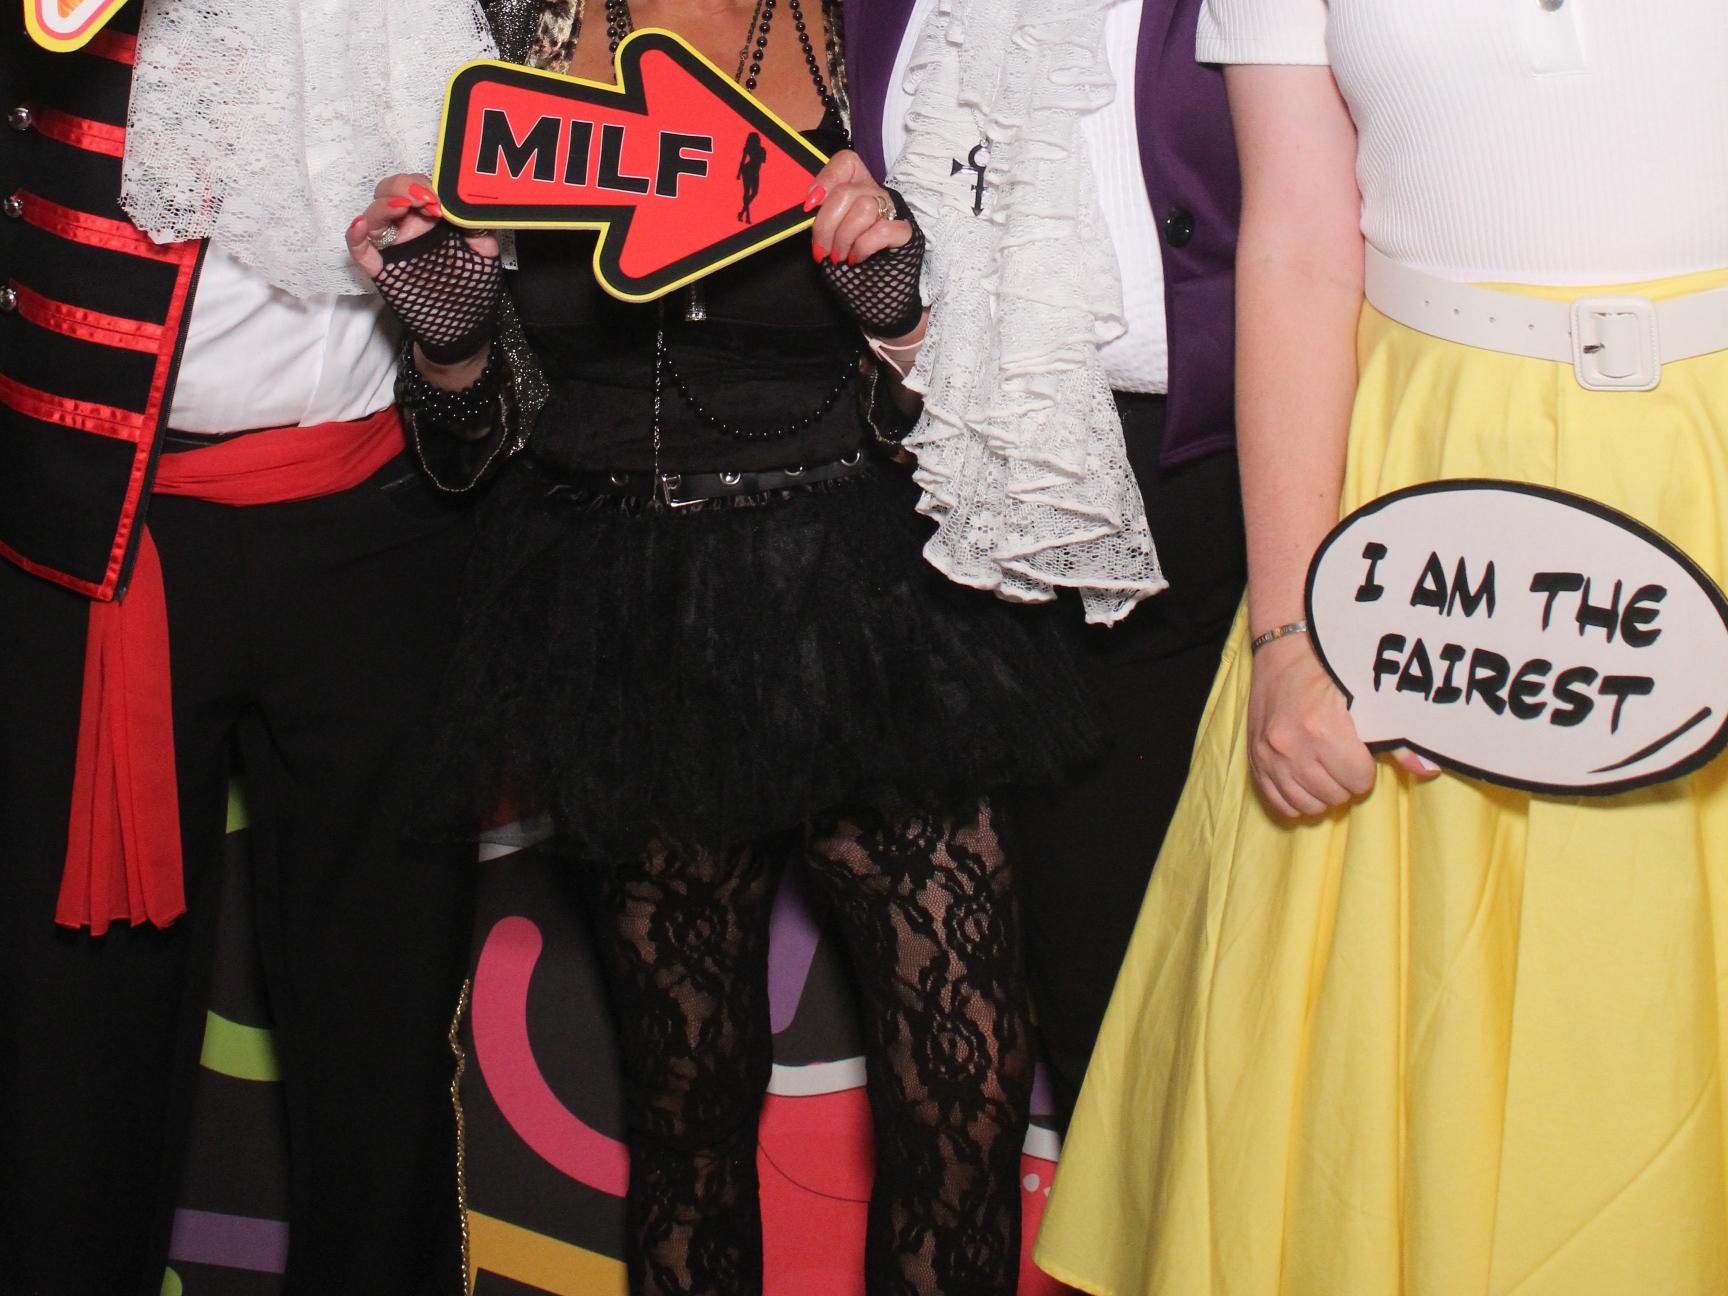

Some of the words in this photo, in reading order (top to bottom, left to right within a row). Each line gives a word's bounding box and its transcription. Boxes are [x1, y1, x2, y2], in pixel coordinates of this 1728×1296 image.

[475, 108, 713, 198] MILF
[1355, 542, 1387, 602] I
[1410, 551, 1496, 619] AM
[1529, 572, 1667, 648] THE
[1373, 633, 1655, 735] FAIREST
